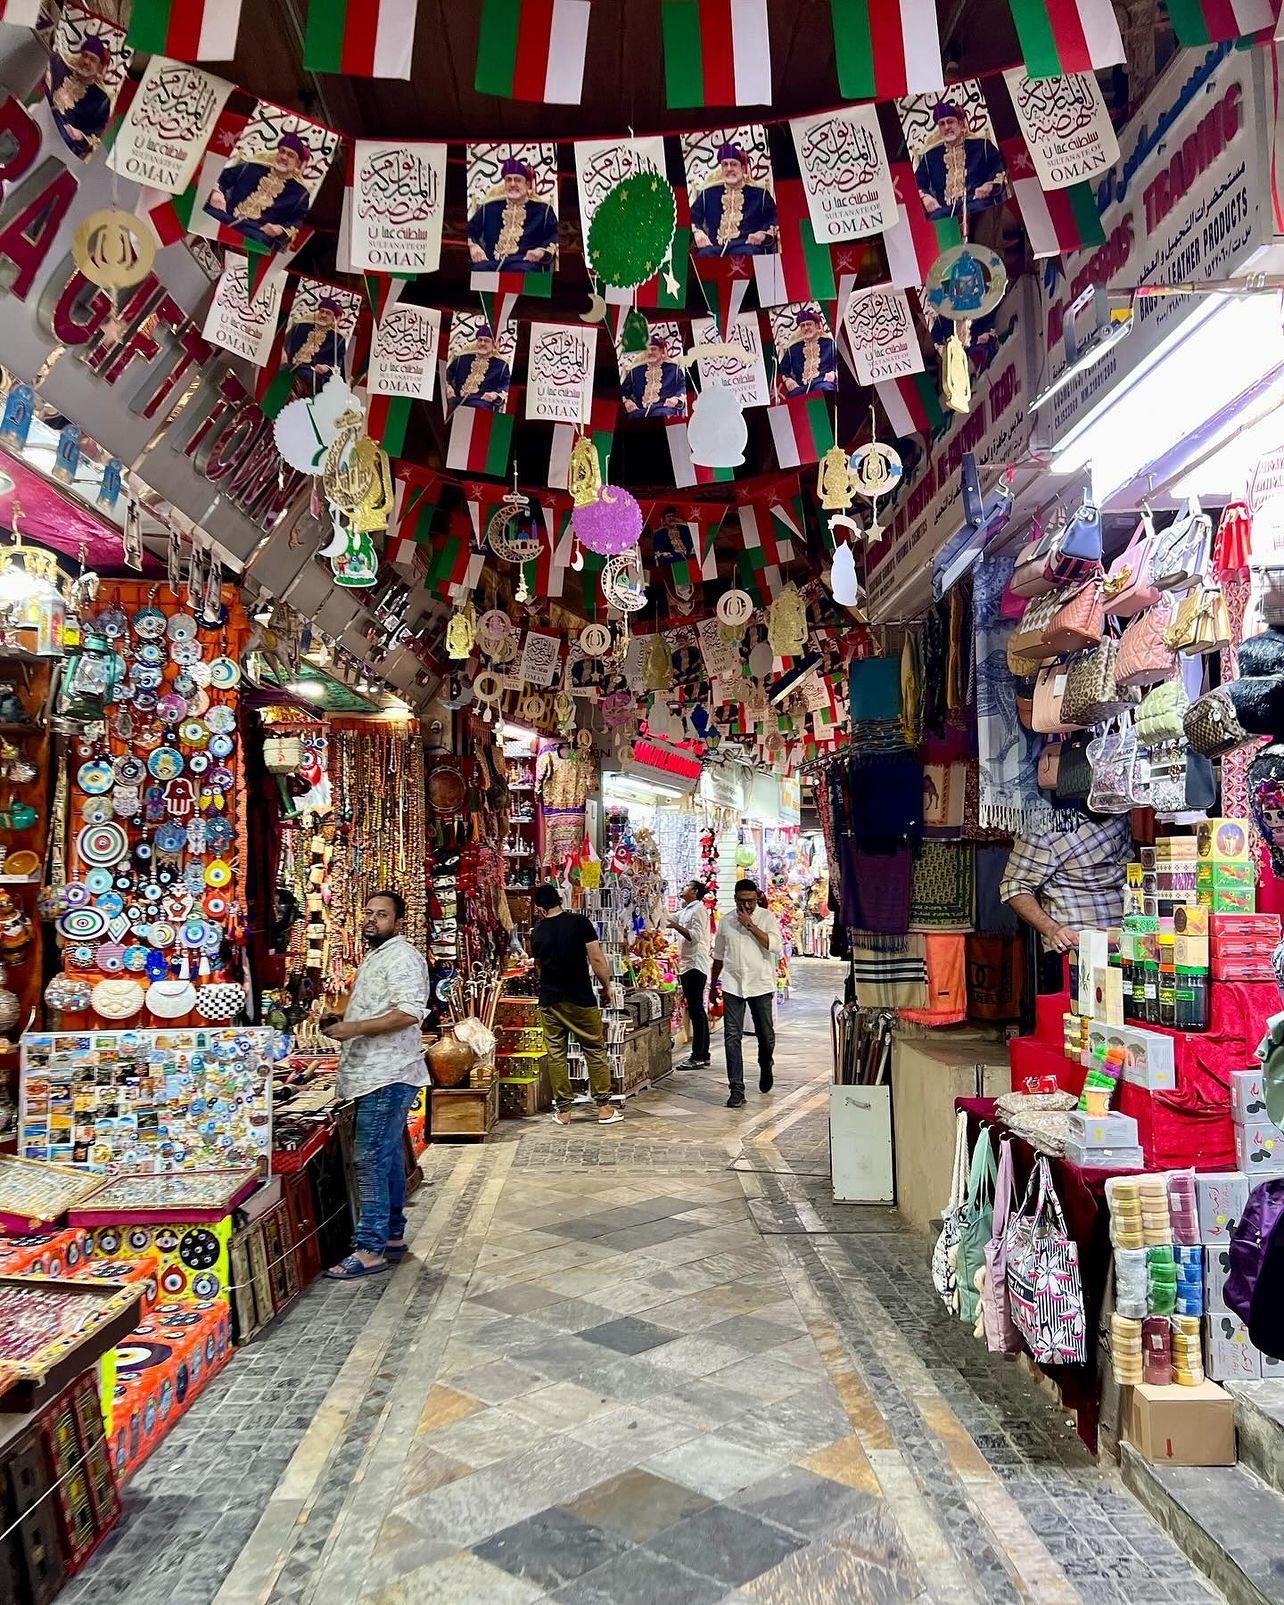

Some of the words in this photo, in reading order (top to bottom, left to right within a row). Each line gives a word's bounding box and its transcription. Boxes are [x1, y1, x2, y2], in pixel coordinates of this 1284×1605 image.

[1051, 151, 1106, 182] OMAN
[1143, 80, 1242, 236] TRADING
[126, 158, 179, 186] OMAN
[828, 212, 885, 236] OMAN
[1167, 236, 1201, 285] LEATHER
[1203, 186, 1248, 257] PRODUCTS
[368, 249, 426, 267] OMAN
[52, 266, 217, 420] GIFT
[215, 330, 258, 357] OMAN
[870, 359, 912, 378] OMAN
[378, 379, 422, 393] OMAN
[536, 403, 579, 418] OMAN
